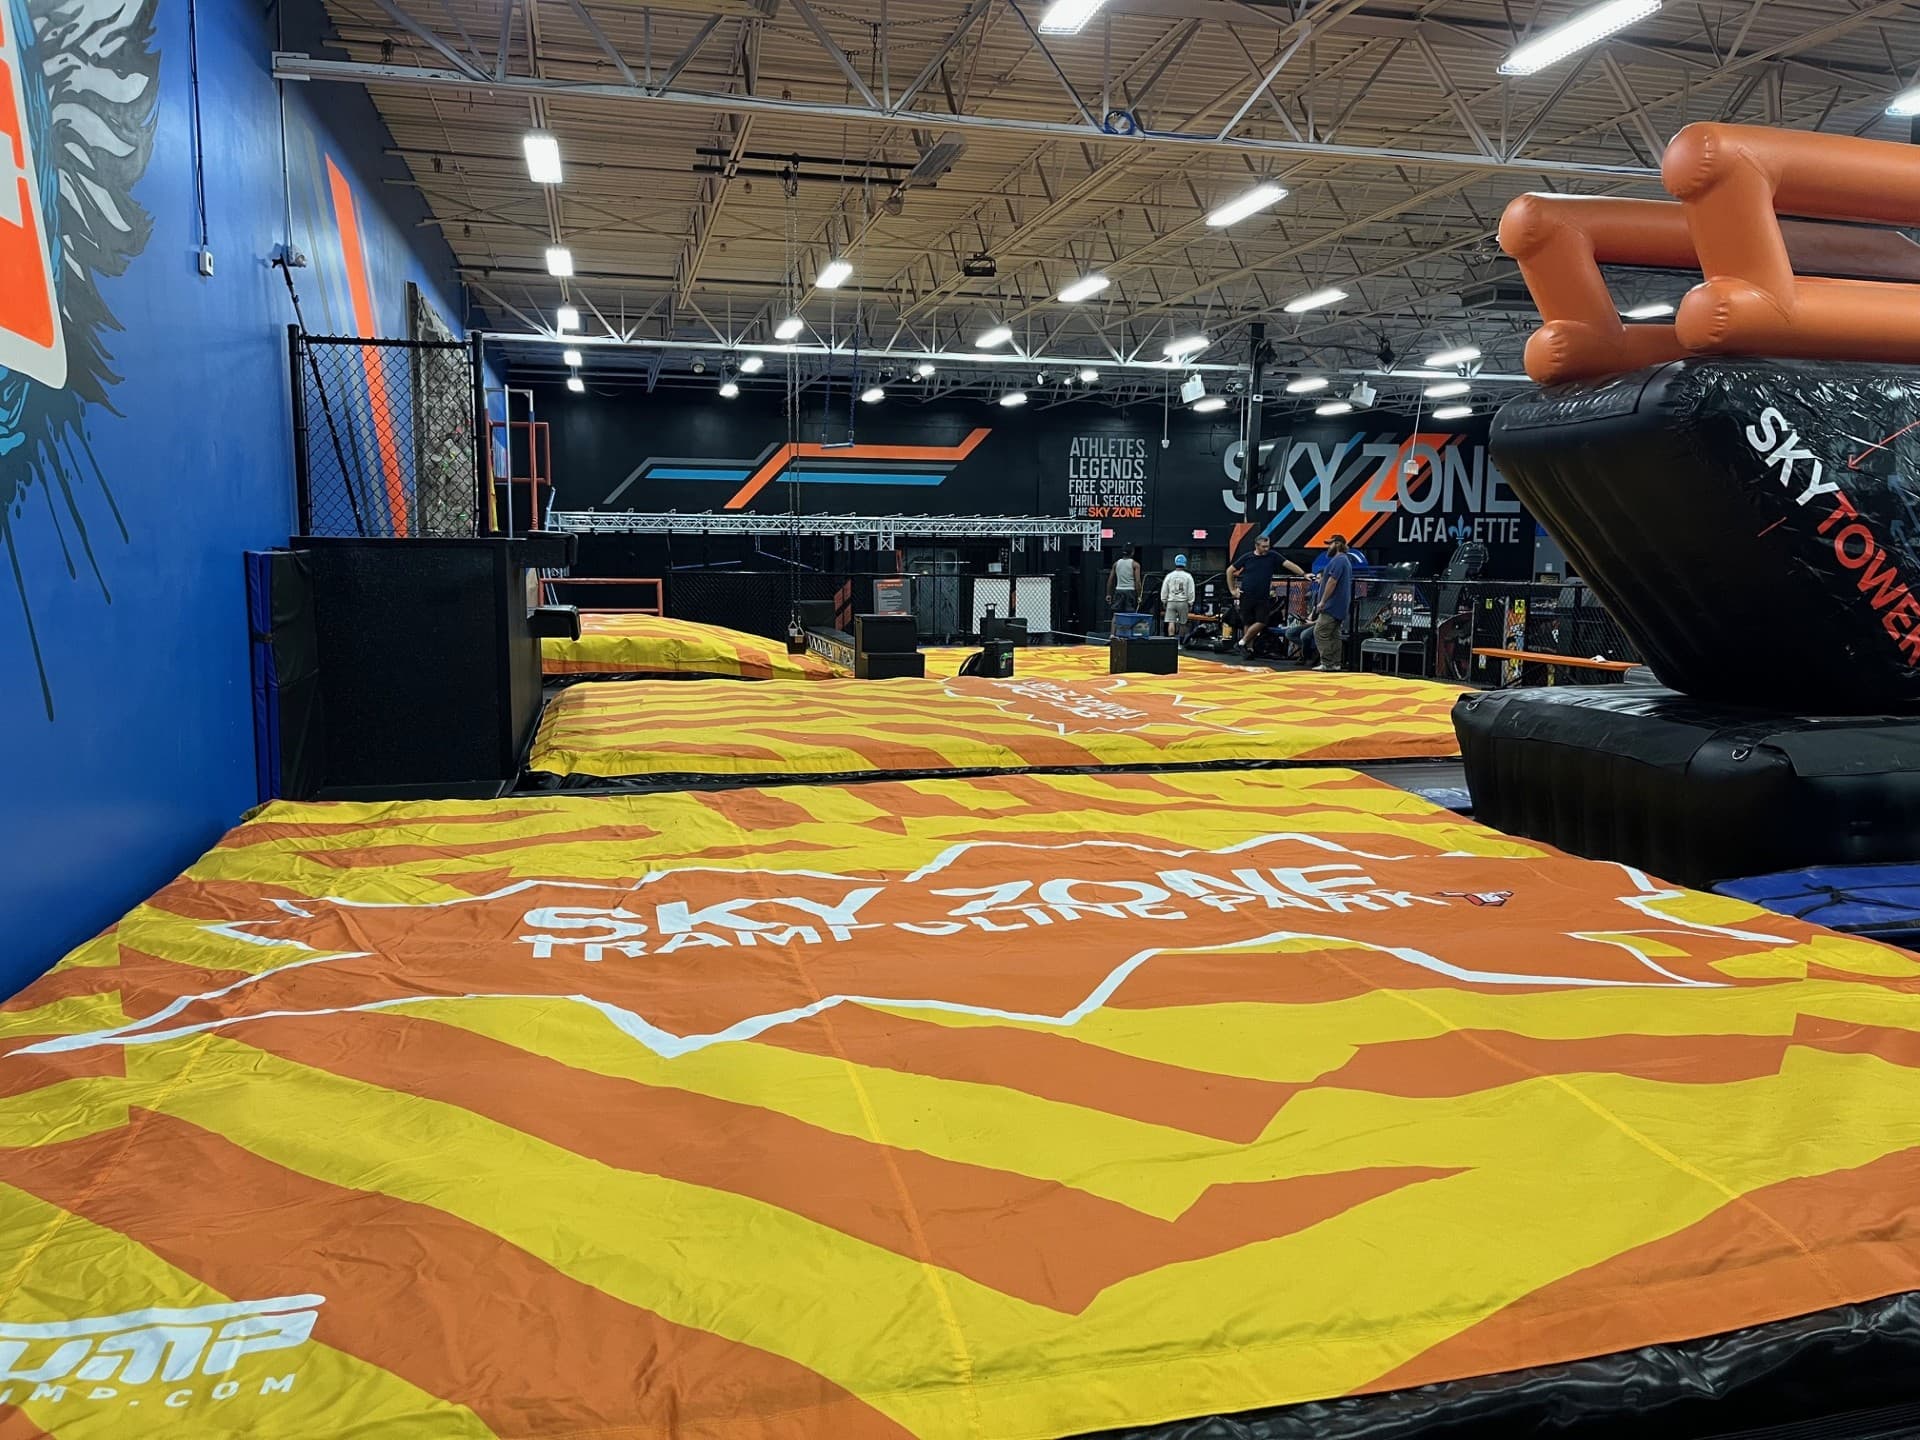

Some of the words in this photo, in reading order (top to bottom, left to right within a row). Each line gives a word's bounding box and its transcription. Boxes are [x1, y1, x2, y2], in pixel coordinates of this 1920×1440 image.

[1069, 437, 1148, 458] ATHLETES.
[1069, 457, 1147, 479] LEGENDS.
[1359, 442, 1521, 514] ZONE
[1069, 479, 1096, 494] FREE
[1099, 479, 1146, 495] SPIRITS.
[1069, 494, 1100, 507] THRILL
[1103, 495, 1146, 507] SEEKERS.
[1088, 507, 1110, 518] SKY
[1112, 507, 1146, 518] ZONE.
[523, 887, 886, 943] SKY
[929, 864, 1376, 916] ZONE
[1198, 889, 1452, 913] PARK
